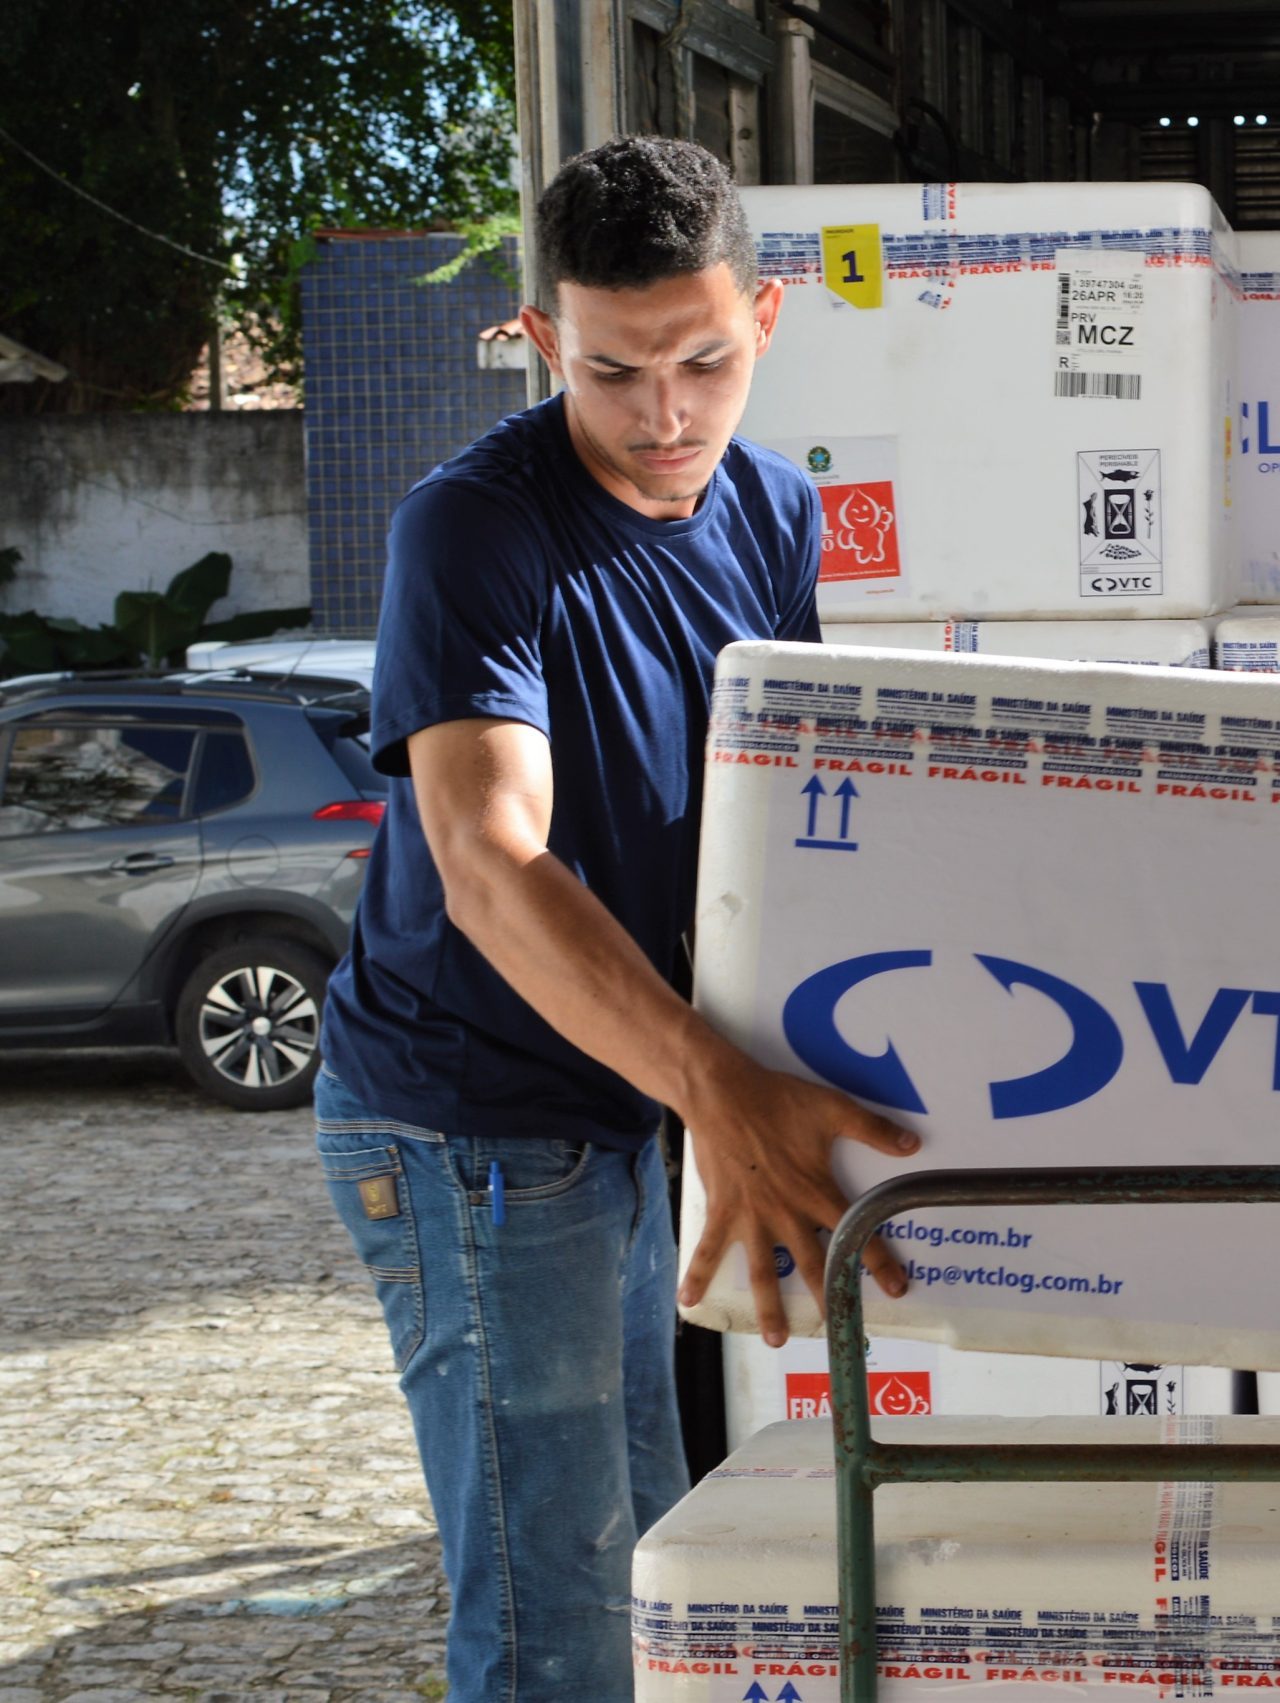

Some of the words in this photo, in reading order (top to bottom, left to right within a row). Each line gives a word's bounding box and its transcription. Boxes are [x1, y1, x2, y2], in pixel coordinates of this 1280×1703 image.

[842, 250, 864, 283] 1
[1072, 290, 1116, 302] 26APR
[1071, 313, 1096, 323] PRV
[1078, 324, 1134, 346] MCZ
[1059, 356, 1069, 368] R
[1118, 577, 1152, 589] VTC
[763, 679, 814, 694] MINISTÉRIO
[818, 682, 830, 694] DA
[833, 682, 862, 697] SAÚDE
[877, 687, 929, 701] MINISTÉRIO
[932, 691, 943, 702] DA
[947, 690, 977, 705] SAÚDE
[992, 696, 1043, 711] MINISTÉRIO
[1046, 701, 1058, 712] DA
[1062, 701, 1091, 715] SAÚDE
[1106, 705, 1158, 721] MINISTÉRIO
[1161, 710, 1173, 722] DA
[1177, 709, 1206, 725] SAÚDE
[1221, 715, 1272, 731] MINISTÉRIO
[714, 751, 799, 768] FRÁGIL
[814, 756, 912, 776] FRÁGIL
[928, 765, 1026, 785] FRÁGIL
[1042, 774, 1142, 793] FRÁGIL
[1157, 782, 1255, 801] FRÁGIL
[877, 1220, 1032, 1249] tclog.com.br
[904, 1260, 1123, 1296] lsp@vtclog.com.br
[791, 1391, 833, 1419] FRÁ
[687, 1602, 739, 1614] MINISTÉRIO
[742, 1604, 755, 1614] DA
[758, 1602, 788, 1615] SAÚDE
[920, 1607, 974, 1620] MINISTÉRIO
[976, 1609, 989, 1620] DA
[992, 1607, 1022, 1621] SAÚDE
[1037, 1609, 1091, 1623] MINISTÉRIO
[1094, 1612, 1106, 1623] DA
[1109, 1610, 1139, 1624] SAÚDE
[648, 1659, 738, 1675] FRÁGIL
[754, 1660, 839, 1677] FRÁGI
[986, 1666, 1088, 1683] FRÁGIL
[1103, 1669, 1206, 1686] FRÁGIL
